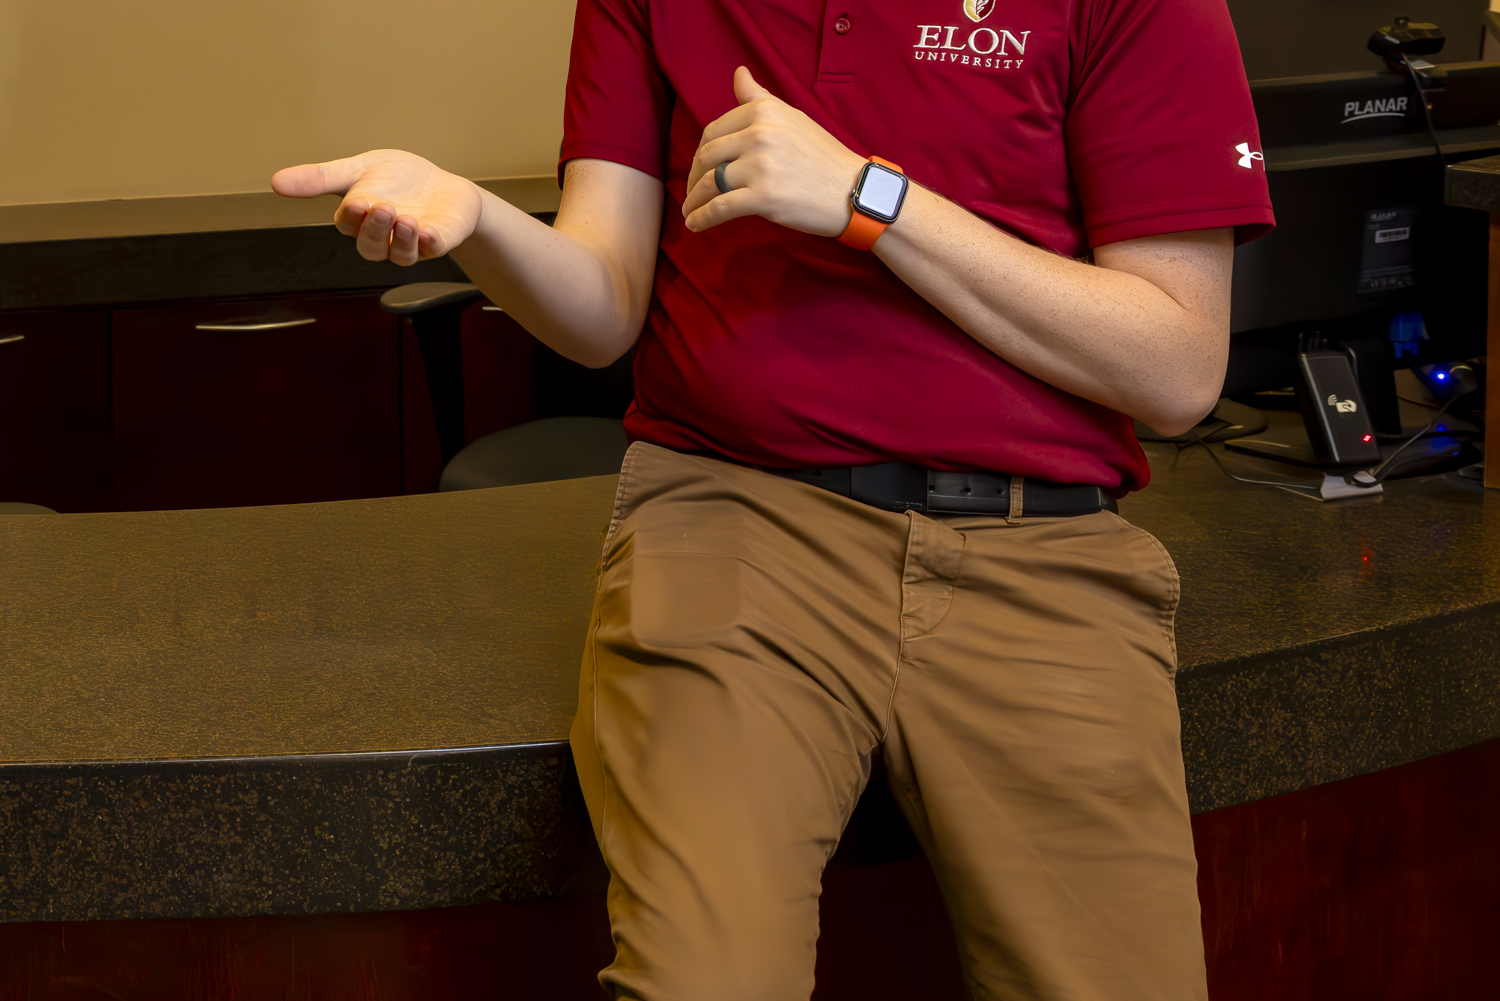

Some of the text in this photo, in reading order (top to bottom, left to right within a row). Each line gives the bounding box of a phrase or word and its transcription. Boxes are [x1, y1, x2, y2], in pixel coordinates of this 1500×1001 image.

[913, 25, 1031, 56] ELON
[915, 51, 1024, 69] UNIVERSITY
[1344, 97, 1408, 116] PLANAR
